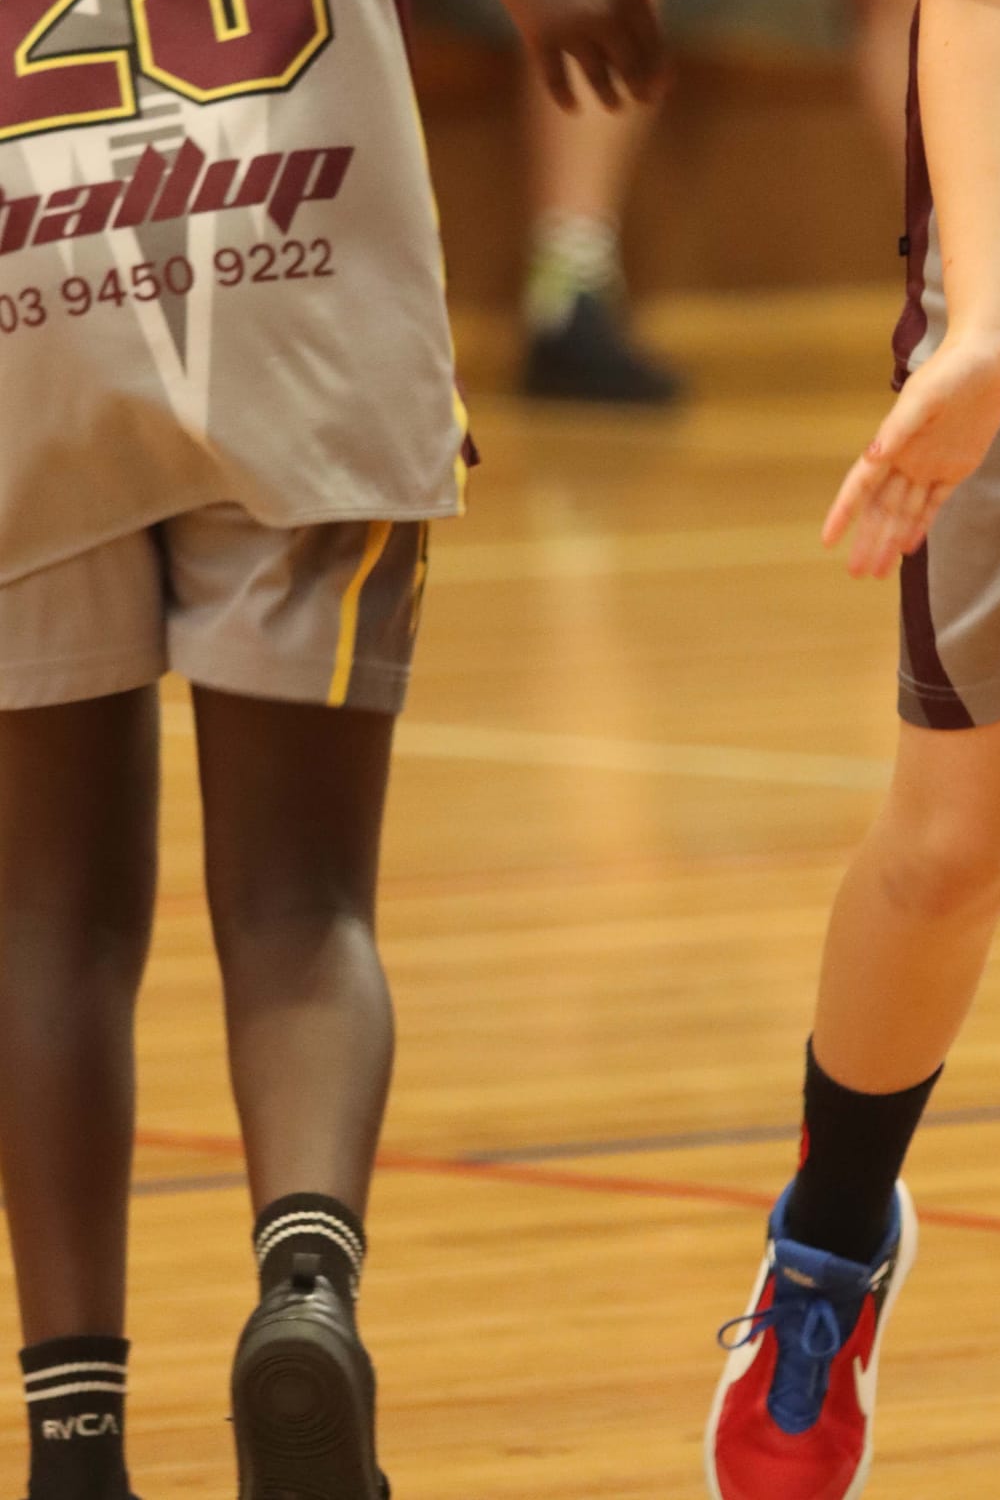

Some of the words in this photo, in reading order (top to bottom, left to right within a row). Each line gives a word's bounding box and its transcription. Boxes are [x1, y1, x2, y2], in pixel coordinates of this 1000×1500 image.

[60, 255, 194, 317] 9450
[213, 237, 335, 287] 9222
[42, 1412, 120, 1441] RVCA
